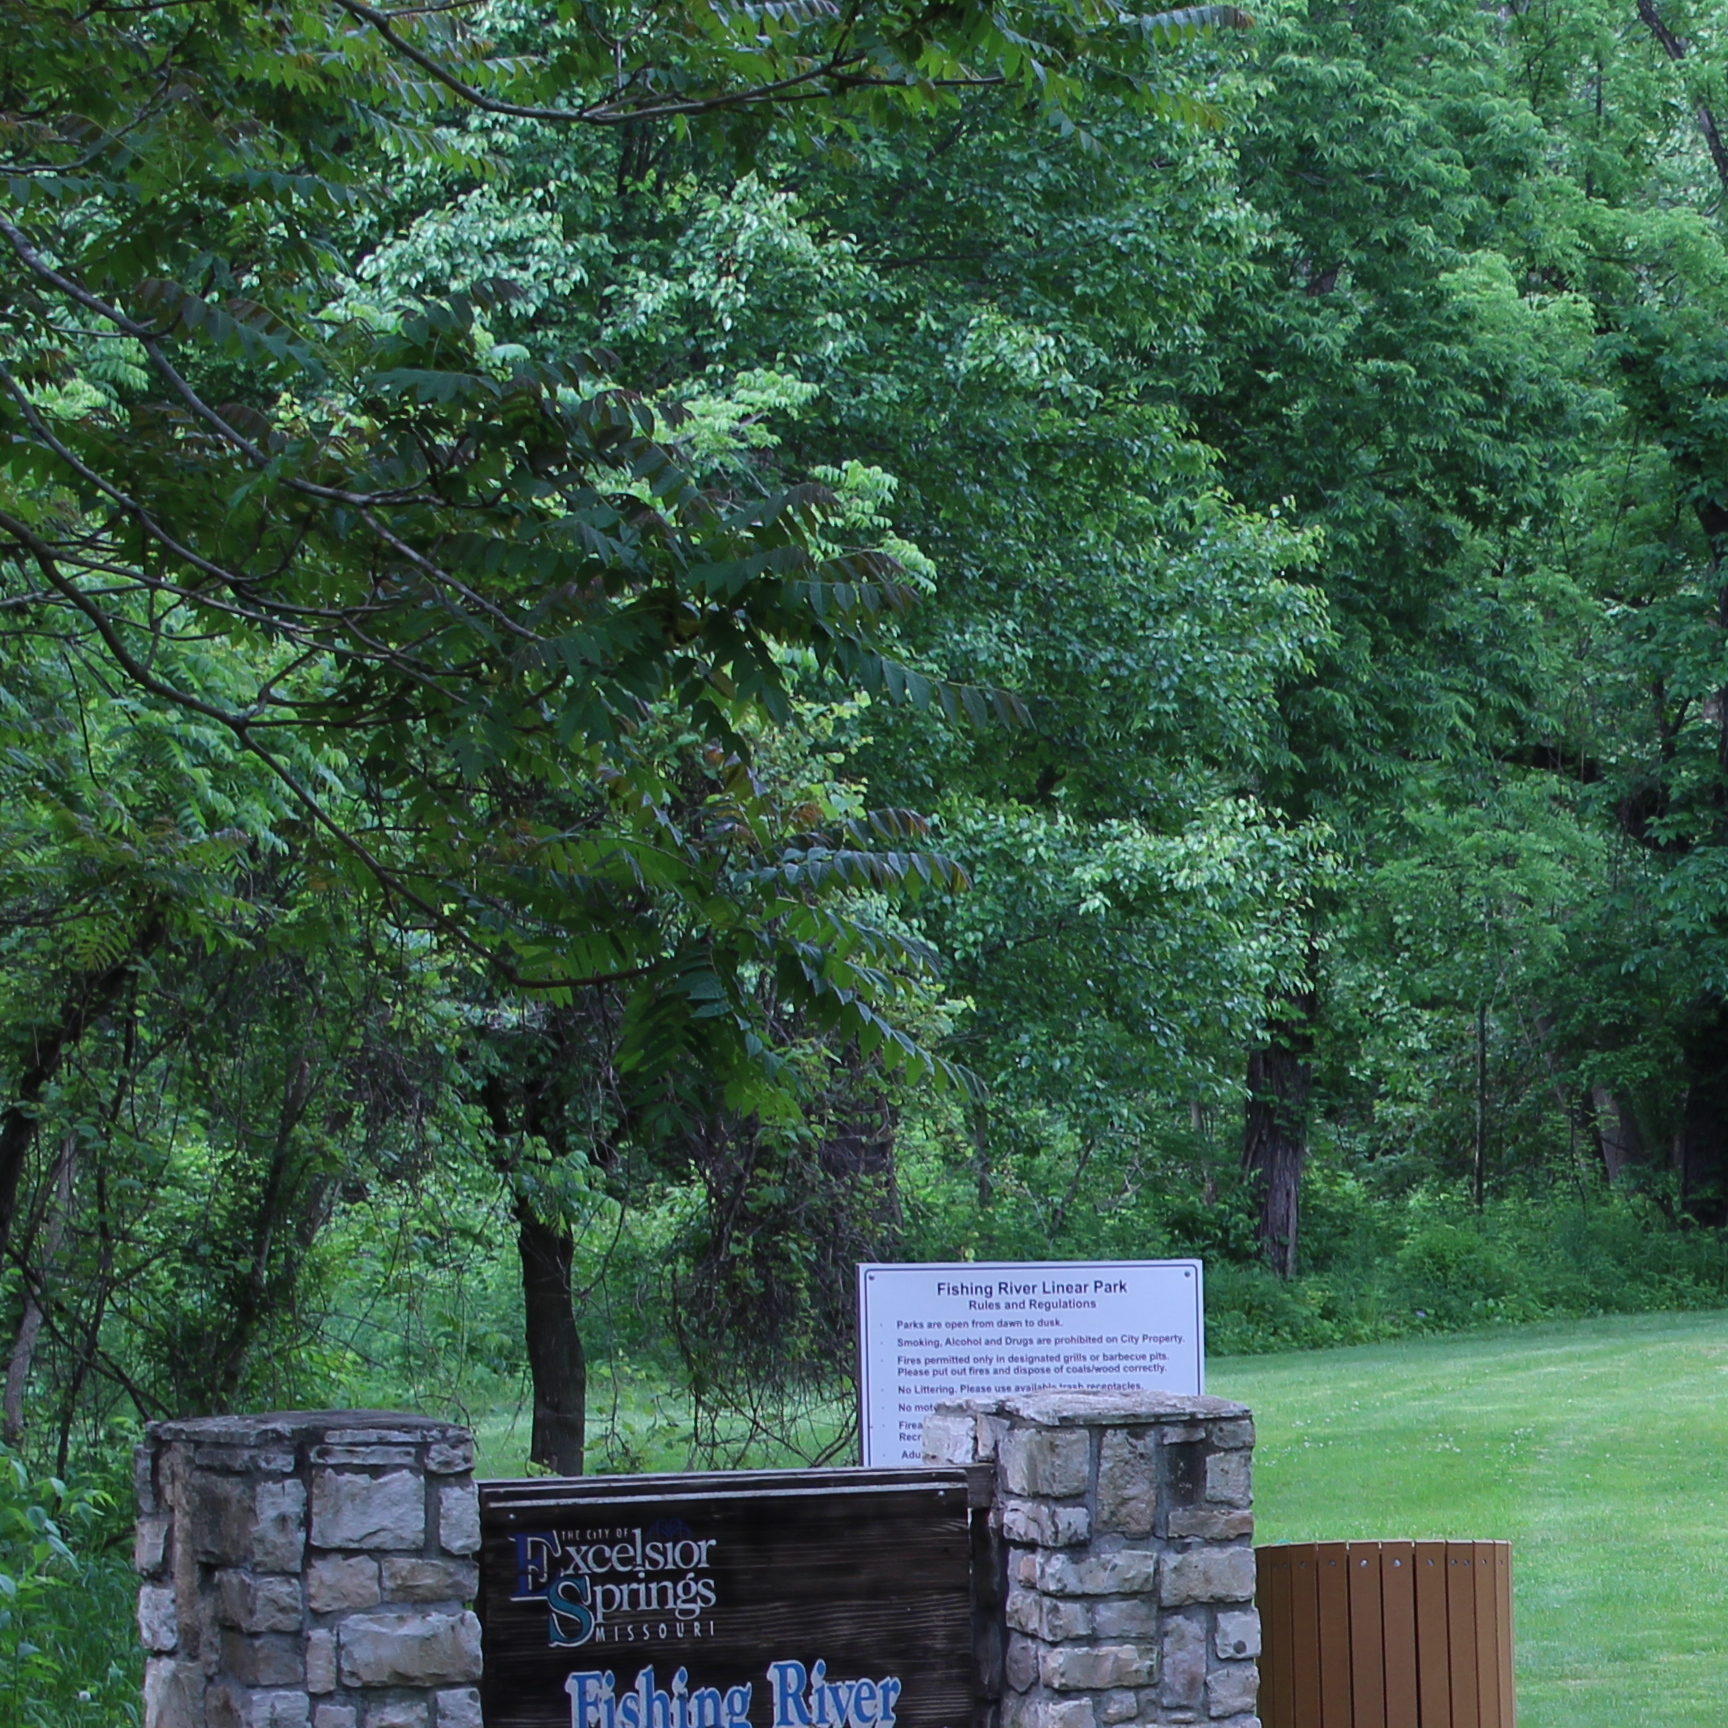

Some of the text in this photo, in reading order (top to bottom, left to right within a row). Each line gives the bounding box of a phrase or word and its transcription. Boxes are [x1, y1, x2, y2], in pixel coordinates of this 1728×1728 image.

[937, 1279, 1127, 1298] Fishing River Linear Park
[968, 1298, 1097, 1311] Rules and Regulations
[896, 1320, 924, 1329] Parks
[944, 1321, 969, 1331] open
[971, 1319, 994, 1328] from
[996, 1318, 1022, 1328] dawn
[1025, 1319, 1034, 1327] to
[1037, 1318, 1063, 1327] dusk.
[897, 1338, 943, 1349] Smoking,
[945, 1337, 982, 1347] Alcohol
[984, 1337, 1003, 1346] and
[1005, 1337, 1034, 1347] Drugs
[1036, 1337, 1051, 1345] are
[1054, 1335, 1103, 1346] prohibited
[1120, 1334, 1139, 1345] City
[1142, 1334, 1185, 1345] Property.
[897, 1352, 1169, 1367] Fires permitted only in designated grills or barbecue pits.
[897, 1363, 1167, 1378] Please put out fires and dispose of coals/wood correctly.
[898, 1385, 911, 1394] No
[914, 1384, 957, 1395] Littering.
[960, 1384, 992, 1393] Please
[994, 1385, 1011, 1393] use
[898, 1403, 912, 1412] No
[562, 1530, 580, 1540] THE
[616, 1528, 629, 1538] OF
[508, 1528, 717, 1601] Excelsior
[548, 1572, 717, 1647] Springs
[595, 1620, 714, 1642] MISSOURI
